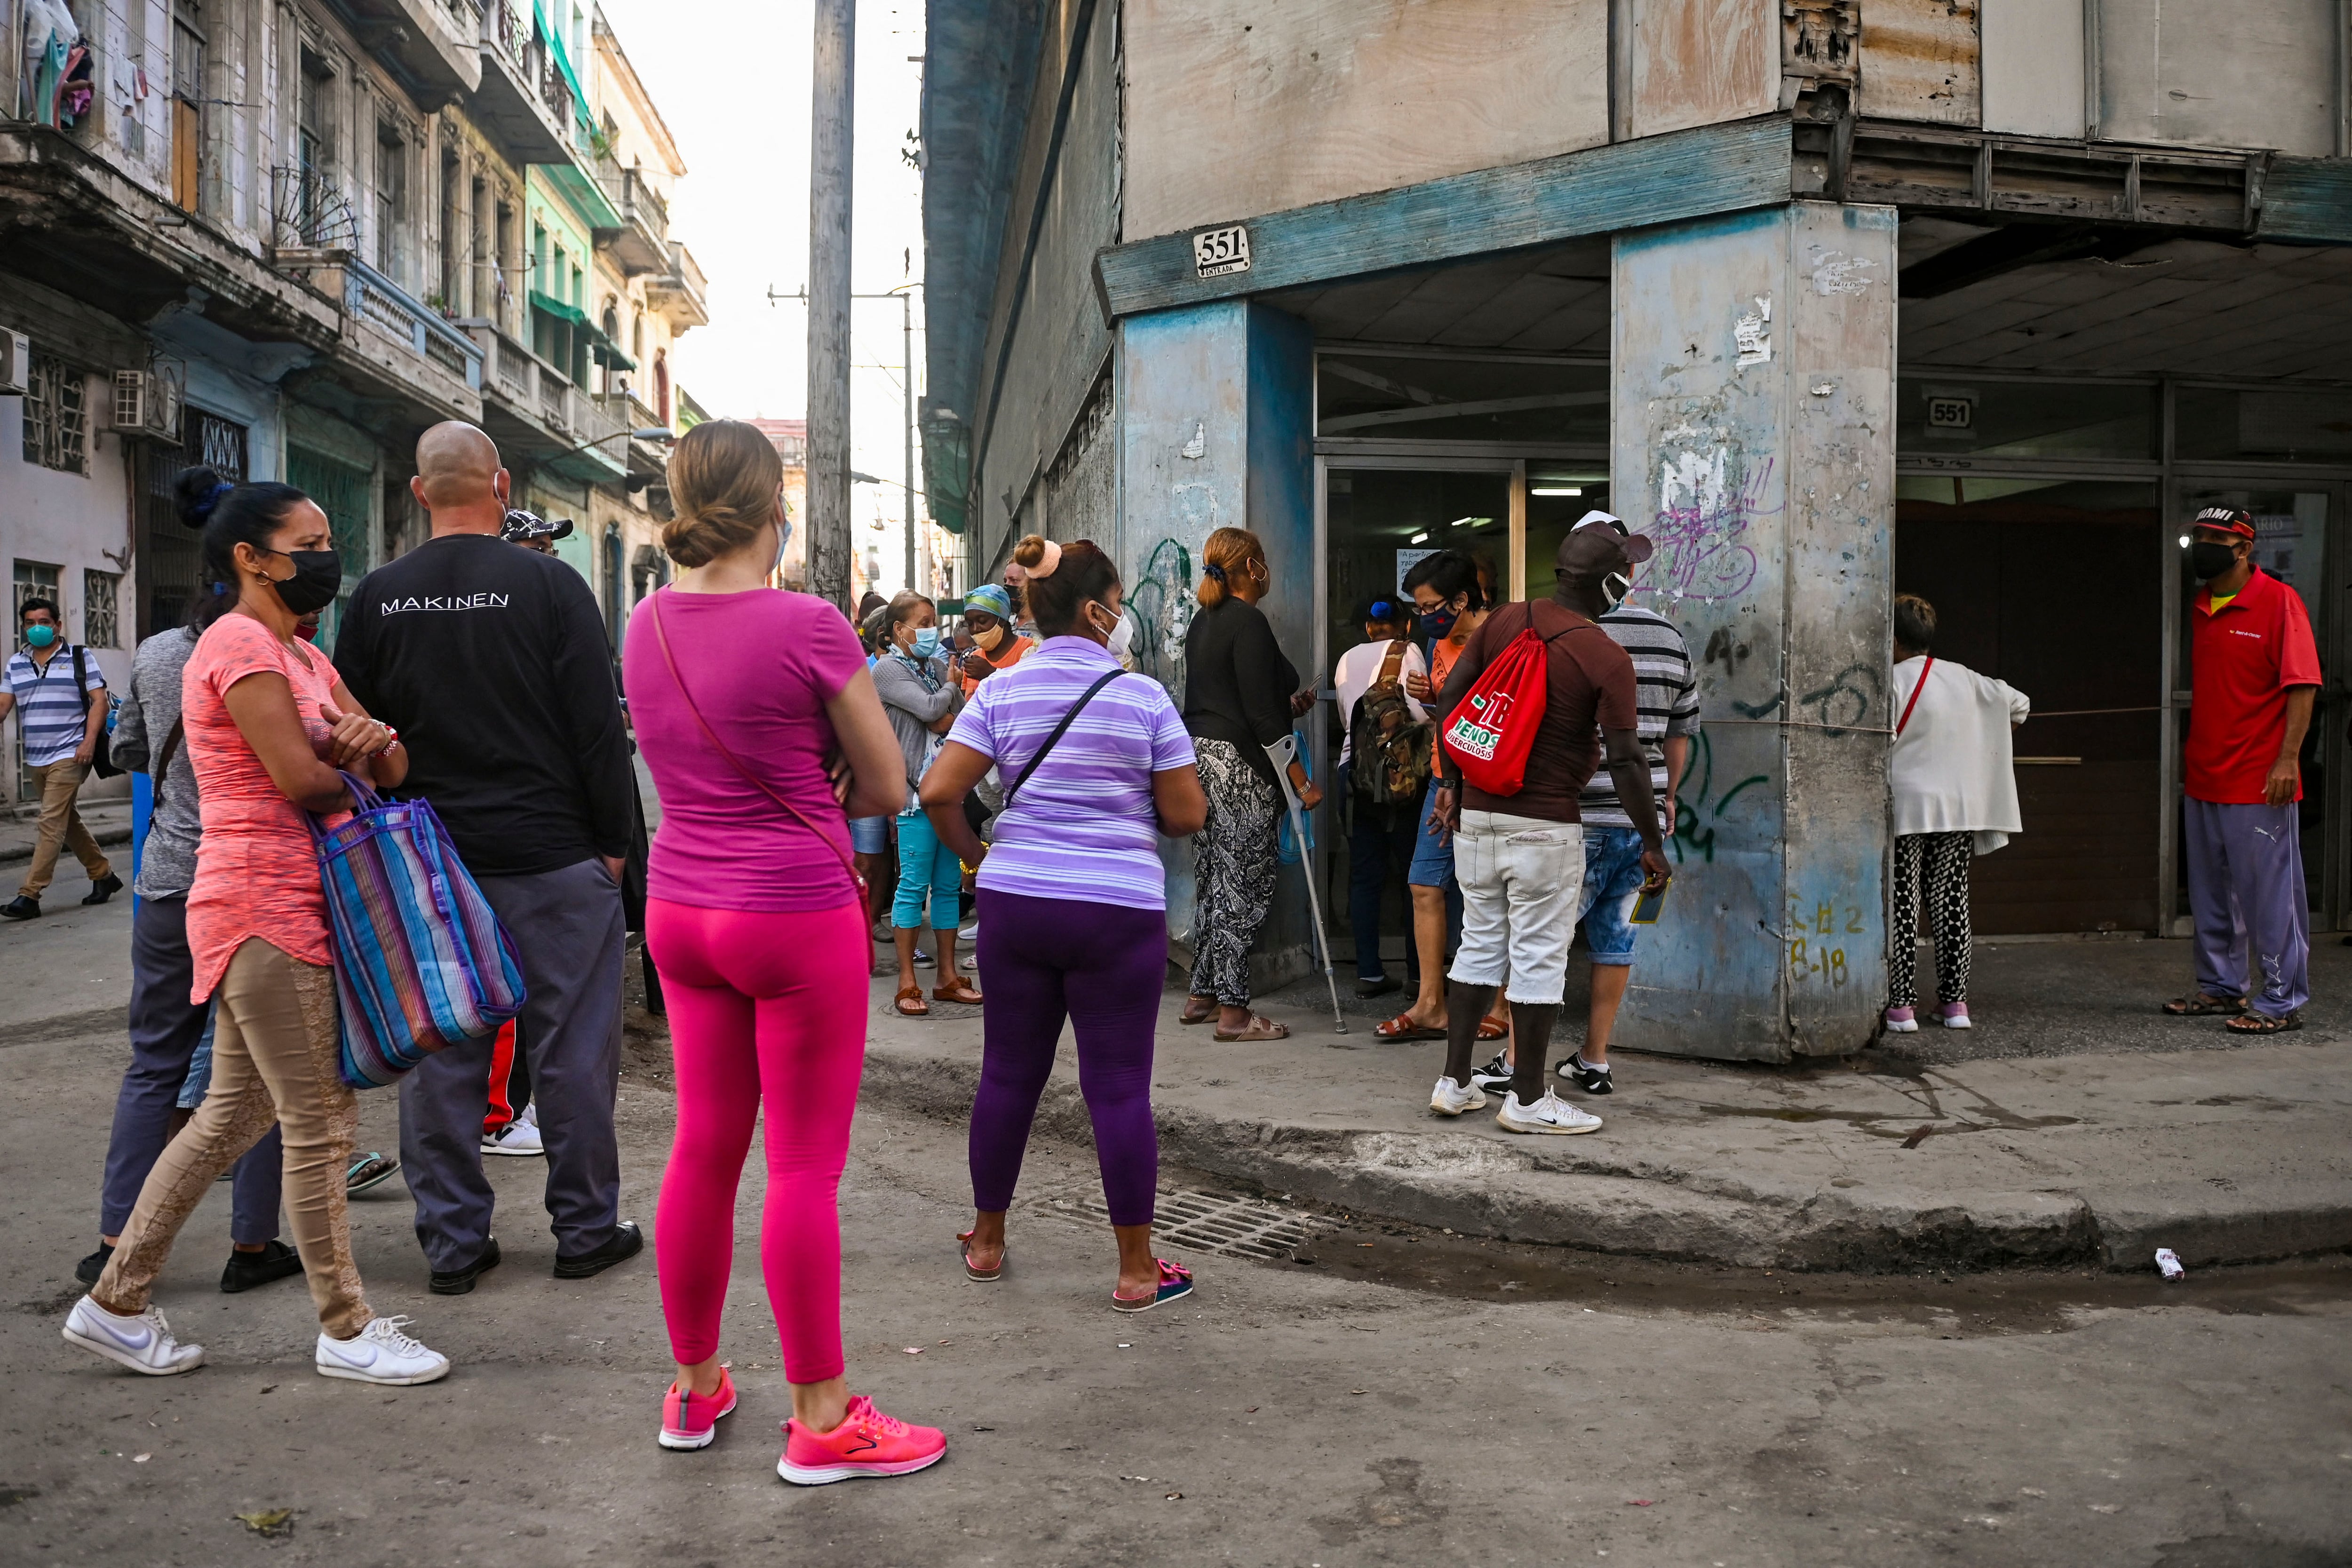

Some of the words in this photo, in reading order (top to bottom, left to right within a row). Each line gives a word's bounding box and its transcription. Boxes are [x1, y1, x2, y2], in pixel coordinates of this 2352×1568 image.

[1202, 229, 1241, 262] 551
[1206, 265, 1233, 276] ENTRADA
[1934, 404, 1965, 422] 551
[381, 593, 509, 615] MAKINEN
